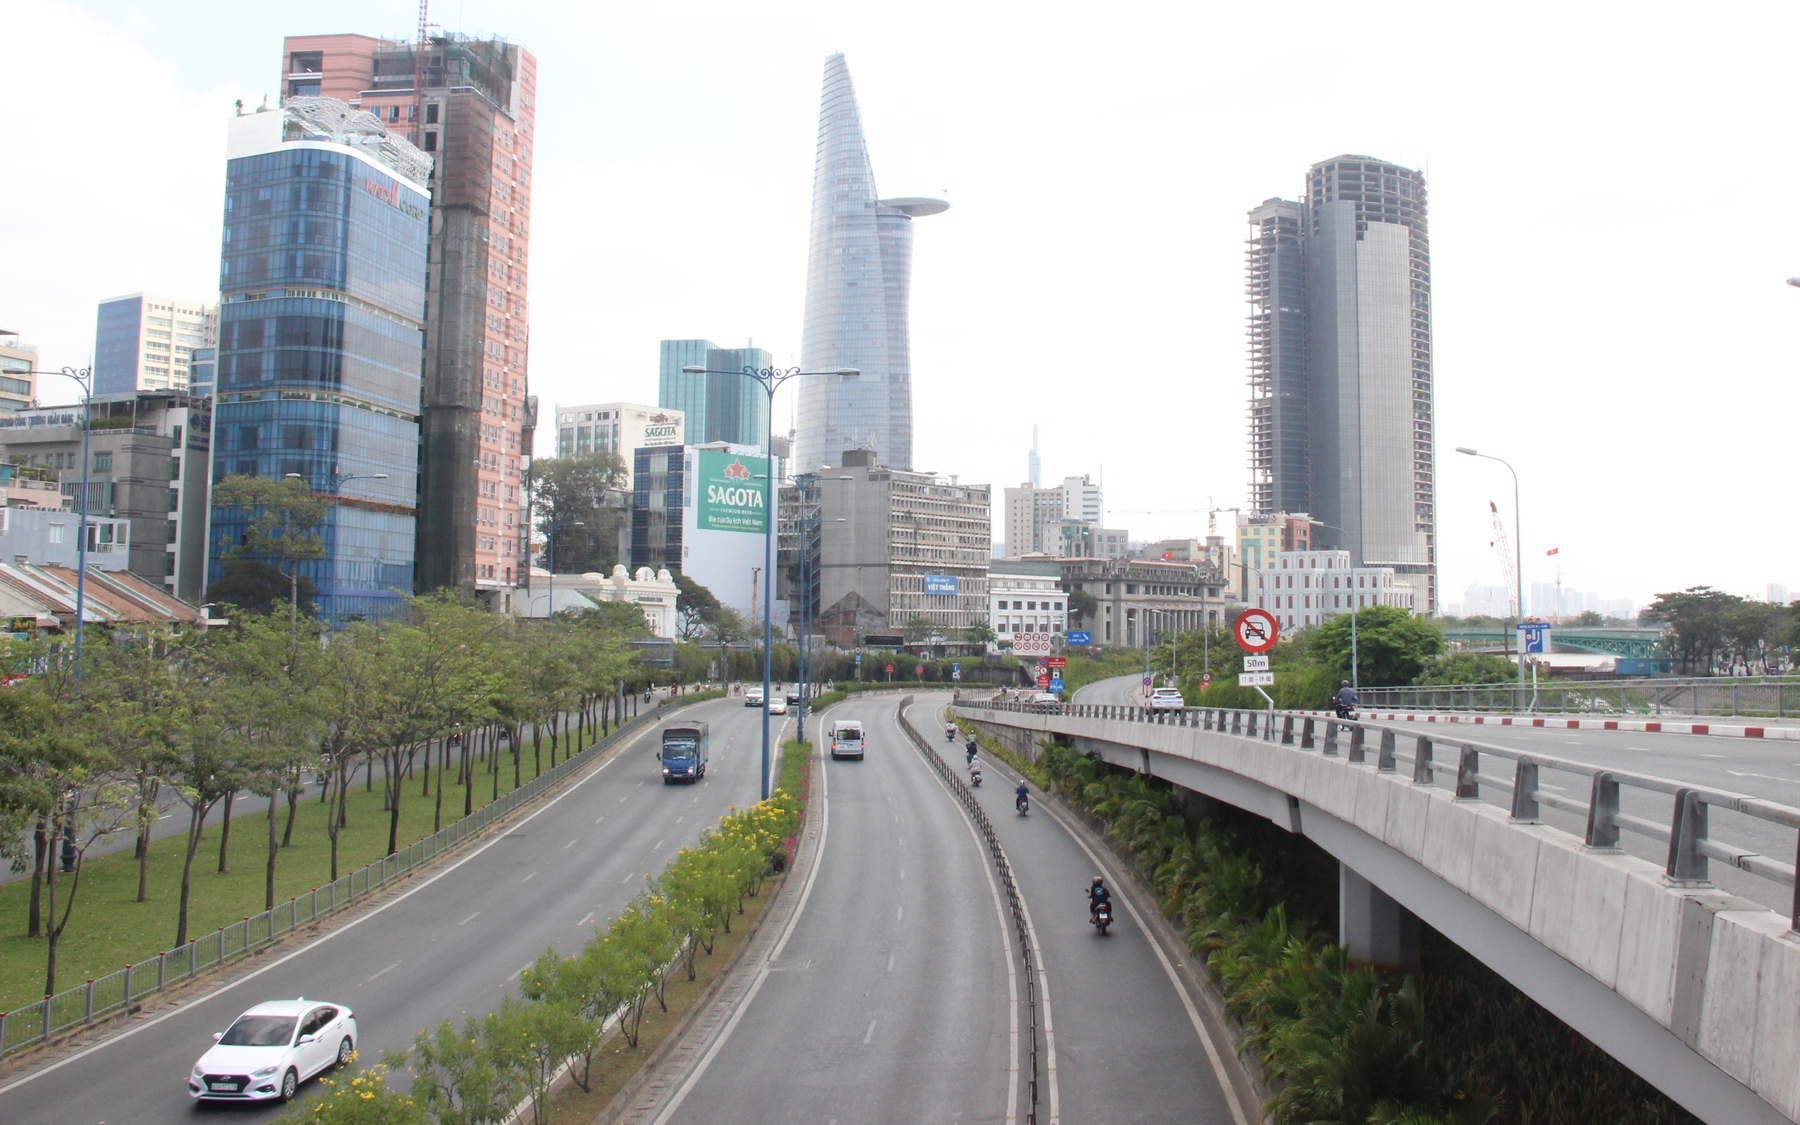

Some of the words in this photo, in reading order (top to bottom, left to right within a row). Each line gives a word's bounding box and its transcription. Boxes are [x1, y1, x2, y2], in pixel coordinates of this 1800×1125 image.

[644, 426, 677, 438] SAGOTA
[708, 485, 763, 507] SAGOTA
[927, 582, 939, 592] VIỆT
[939, 582, 956, 592] THẮNG
